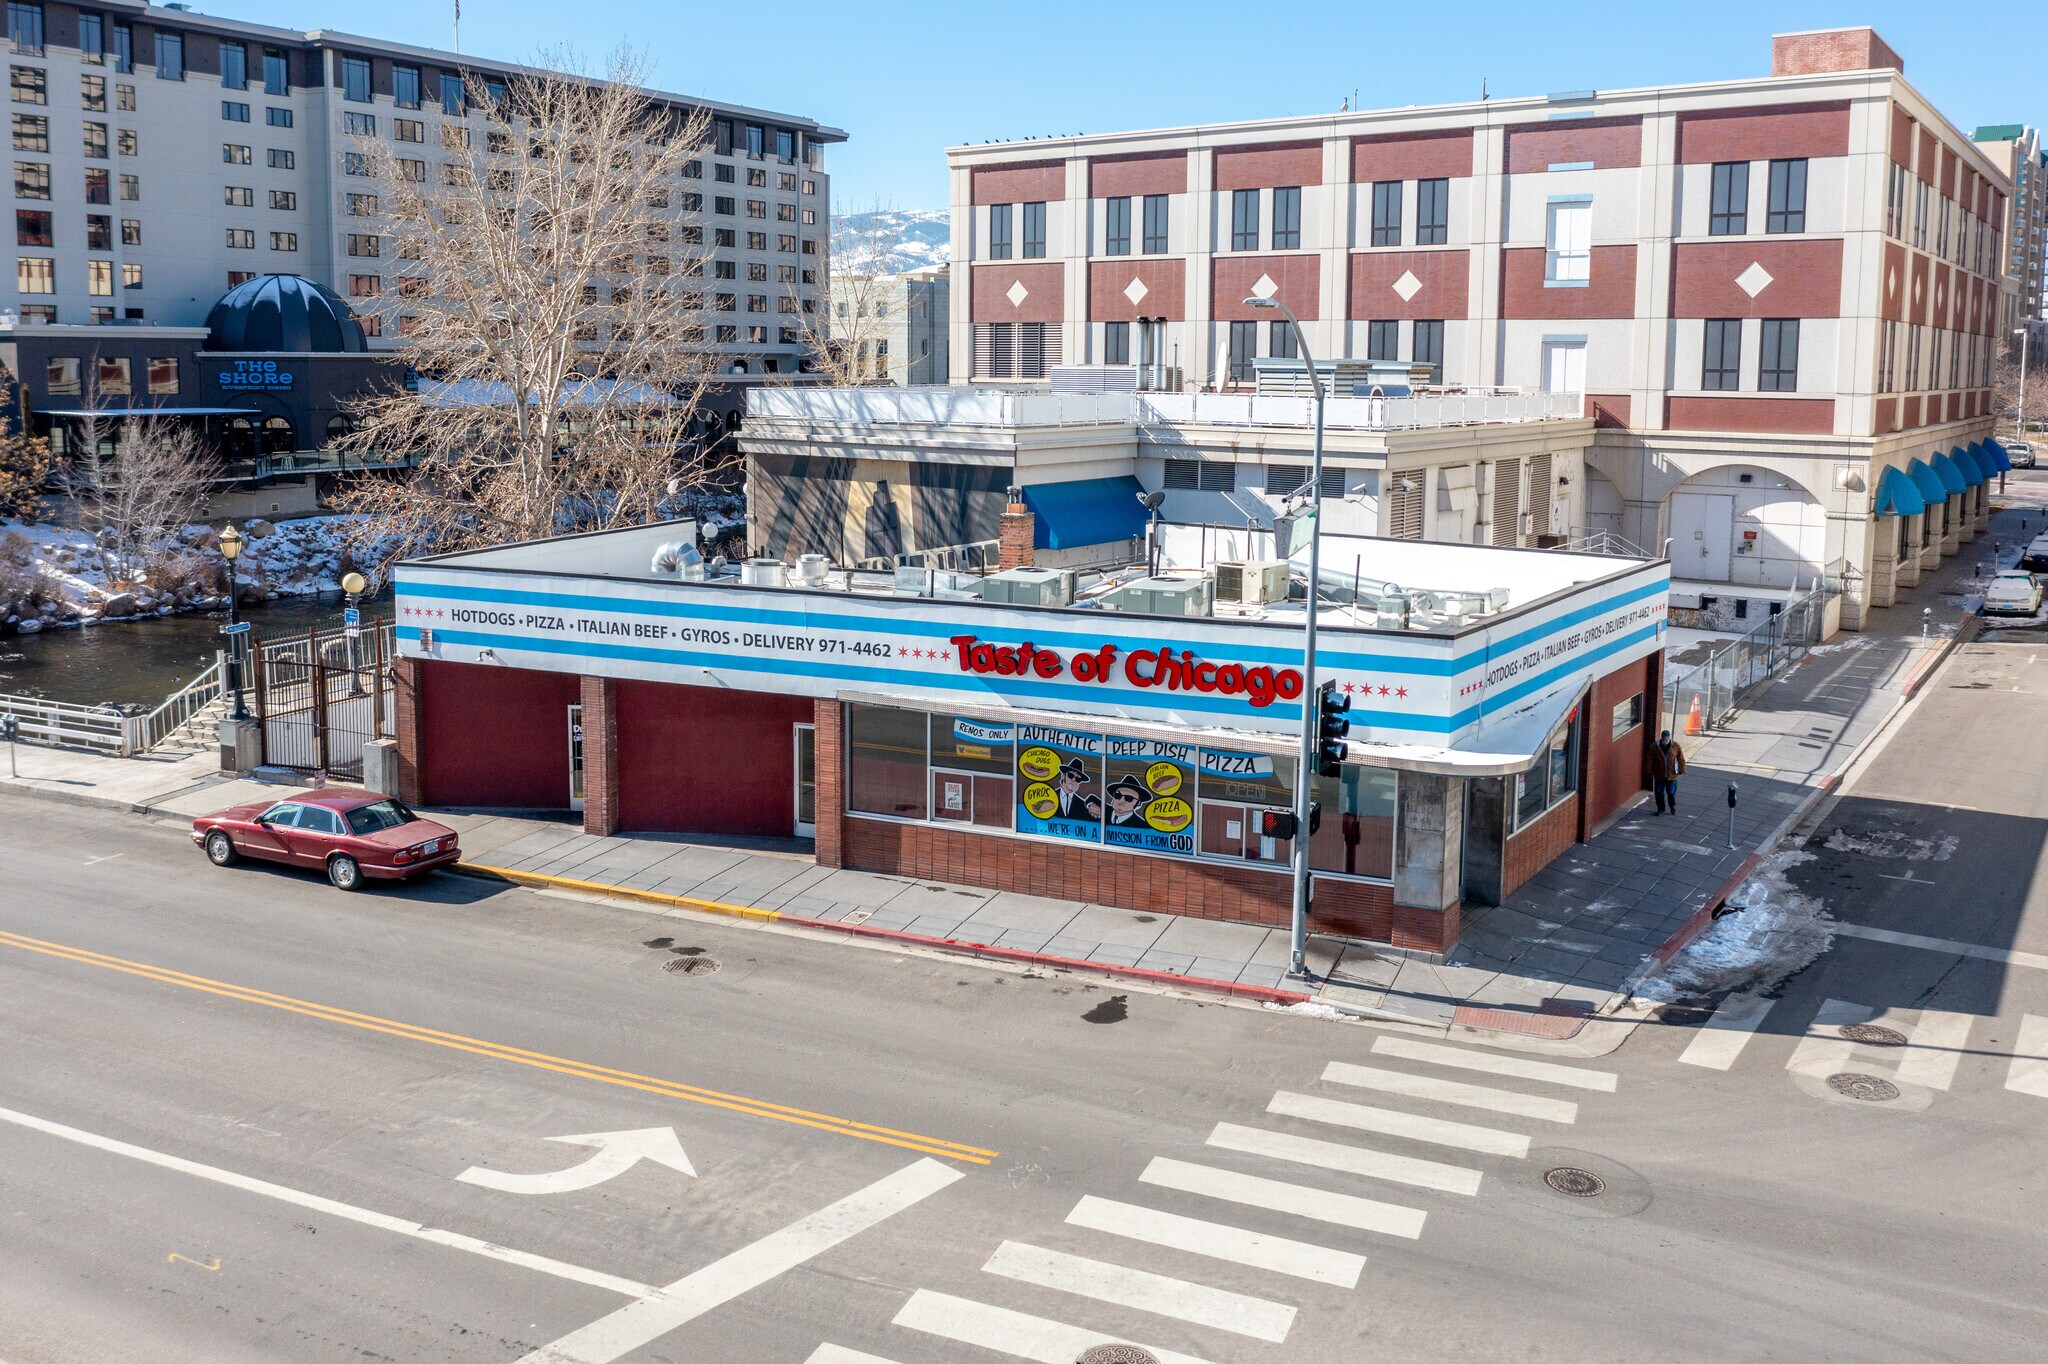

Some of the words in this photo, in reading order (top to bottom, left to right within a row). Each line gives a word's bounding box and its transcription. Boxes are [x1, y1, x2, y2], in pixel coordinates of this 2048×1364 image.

[451, 608, 516, 626] HOTDOGS
[526, 614, 565, 631] PIZZA
[577, 619, 631, 636] ITALIAN
[634, 623, 668, 639] BEEF
[681, 627, 730, 645] GYROS
[743, 632, 815, 652] DELIVERY
[818, 638, 891, 658] 971-4462
[1485, 659, 1518, 689] HOTDOGS
[1522, 650, 1541, 671] PIZZA
[1544, 641, 1567, 663] ITALIAN
[1567, 632, 1581, 651] BEEF
[1584, 625, 1602, 644] GYROS
[1605, 615, 1628, 636] DELIVERY
[1629, 606, 1650, 628] 971-4462
[950, 634, 1062, 679] Taste
[1070, 643, 1117, 684] of
[1124, 646, 1304, 708] Chicago
[959, 722, 985, 737] RENOS
[988, 729, 1009, 740] ONLY
[1023, 726, 1097, 751] AUTHENTIC
[1112, 741, 1147, 756] DEEP
[1149, 740, 1189, 762] DISH
[1206, 754, 1256, 774] PIZZA
[1153, 770, 1165, 780] BEEF
[1028, 788, 1050, 800] GYROS
[1227, 782, 1264, 798] OPEN
[1153, 801, 1180, 814] PIZZA
[1074, 825, 1087, 838] ON
[1091, 827, 1098, 839] A
[1106, 829, 1142, 844] MISSION
[1145, 834, 1169, 848] FROM
[1169, 833, 1194, 852] GOD
